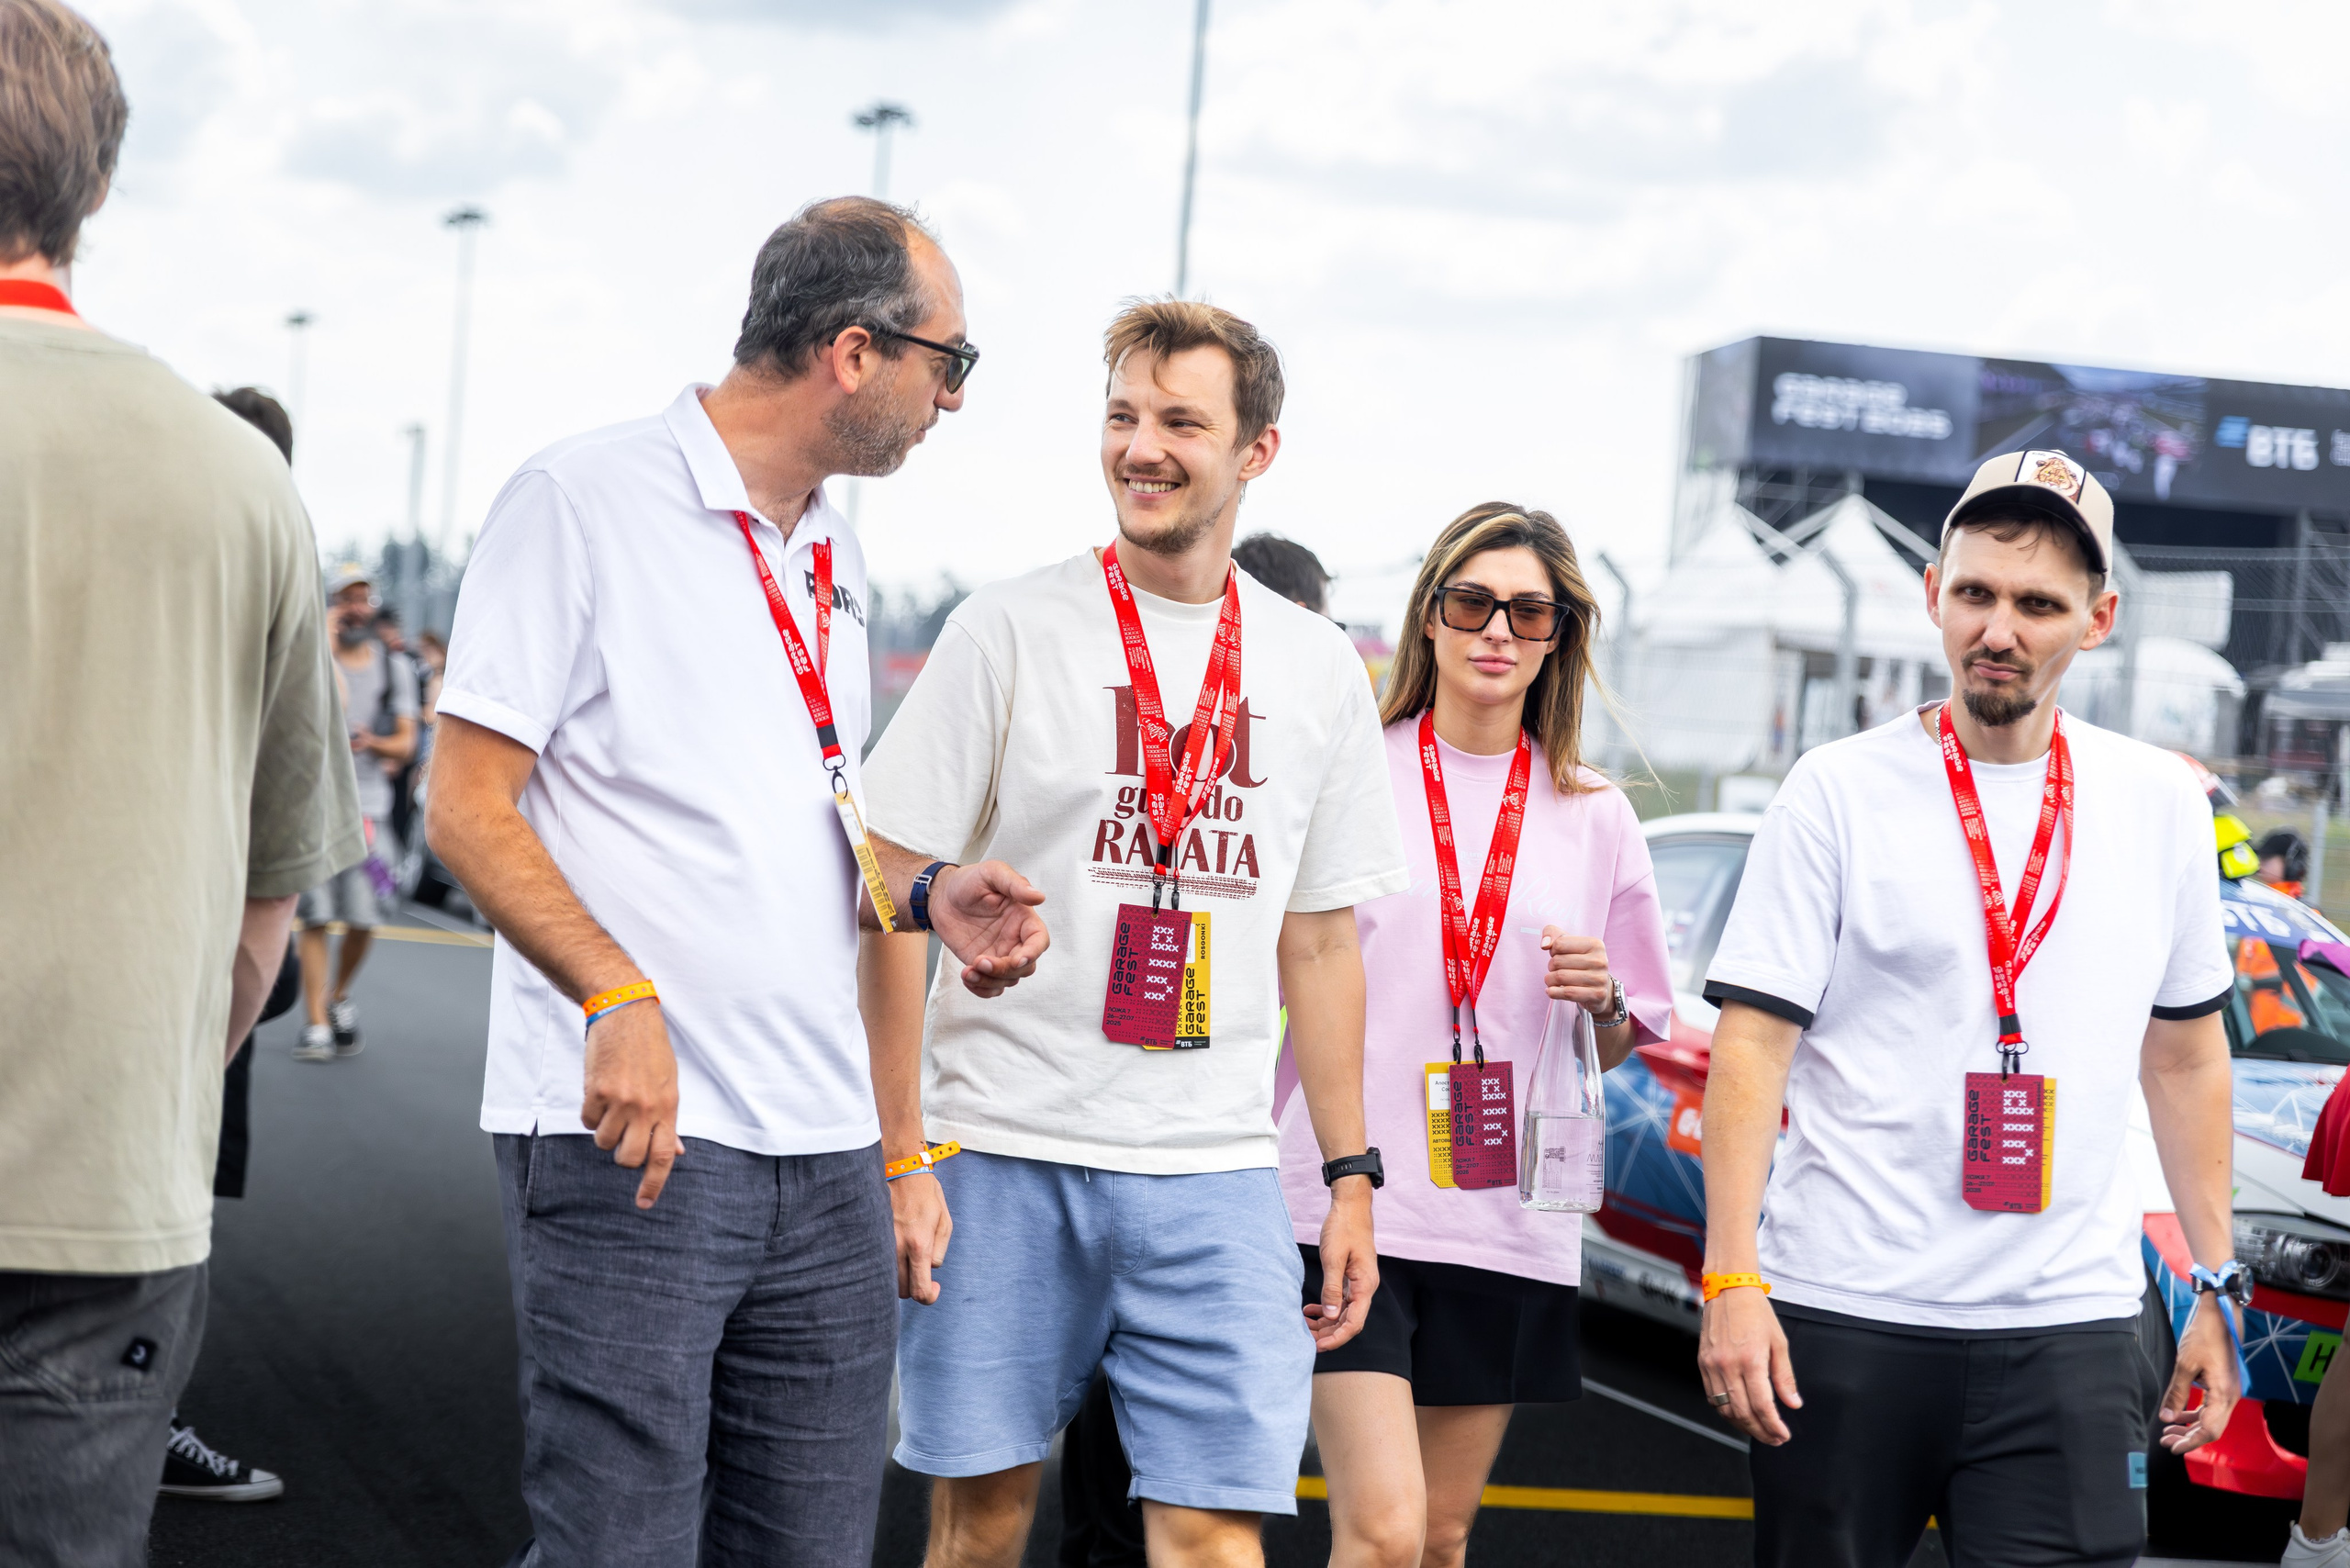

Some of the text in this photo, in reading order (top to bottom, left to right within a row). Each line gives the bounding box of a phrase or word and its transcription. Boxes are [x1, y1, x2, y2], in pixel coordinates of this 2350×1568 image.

[1092, 820, 1260, 879] RAATA
[1112, 922, 1131, 994] GaRaGe
[1124, 951, 1139, 996] FeST
[1185, 967, 1195, 1035] GaRaGe
[1196, 990, 1205, 1035] FeST
[1453, 1081, 1464, 1147] GaRaGe
[1464, 1102, 1475, 1146] FeST
[1967, 1089, 1979, 1162] GaRaGe
[1980, 1114, 1991, 1162] FeST
